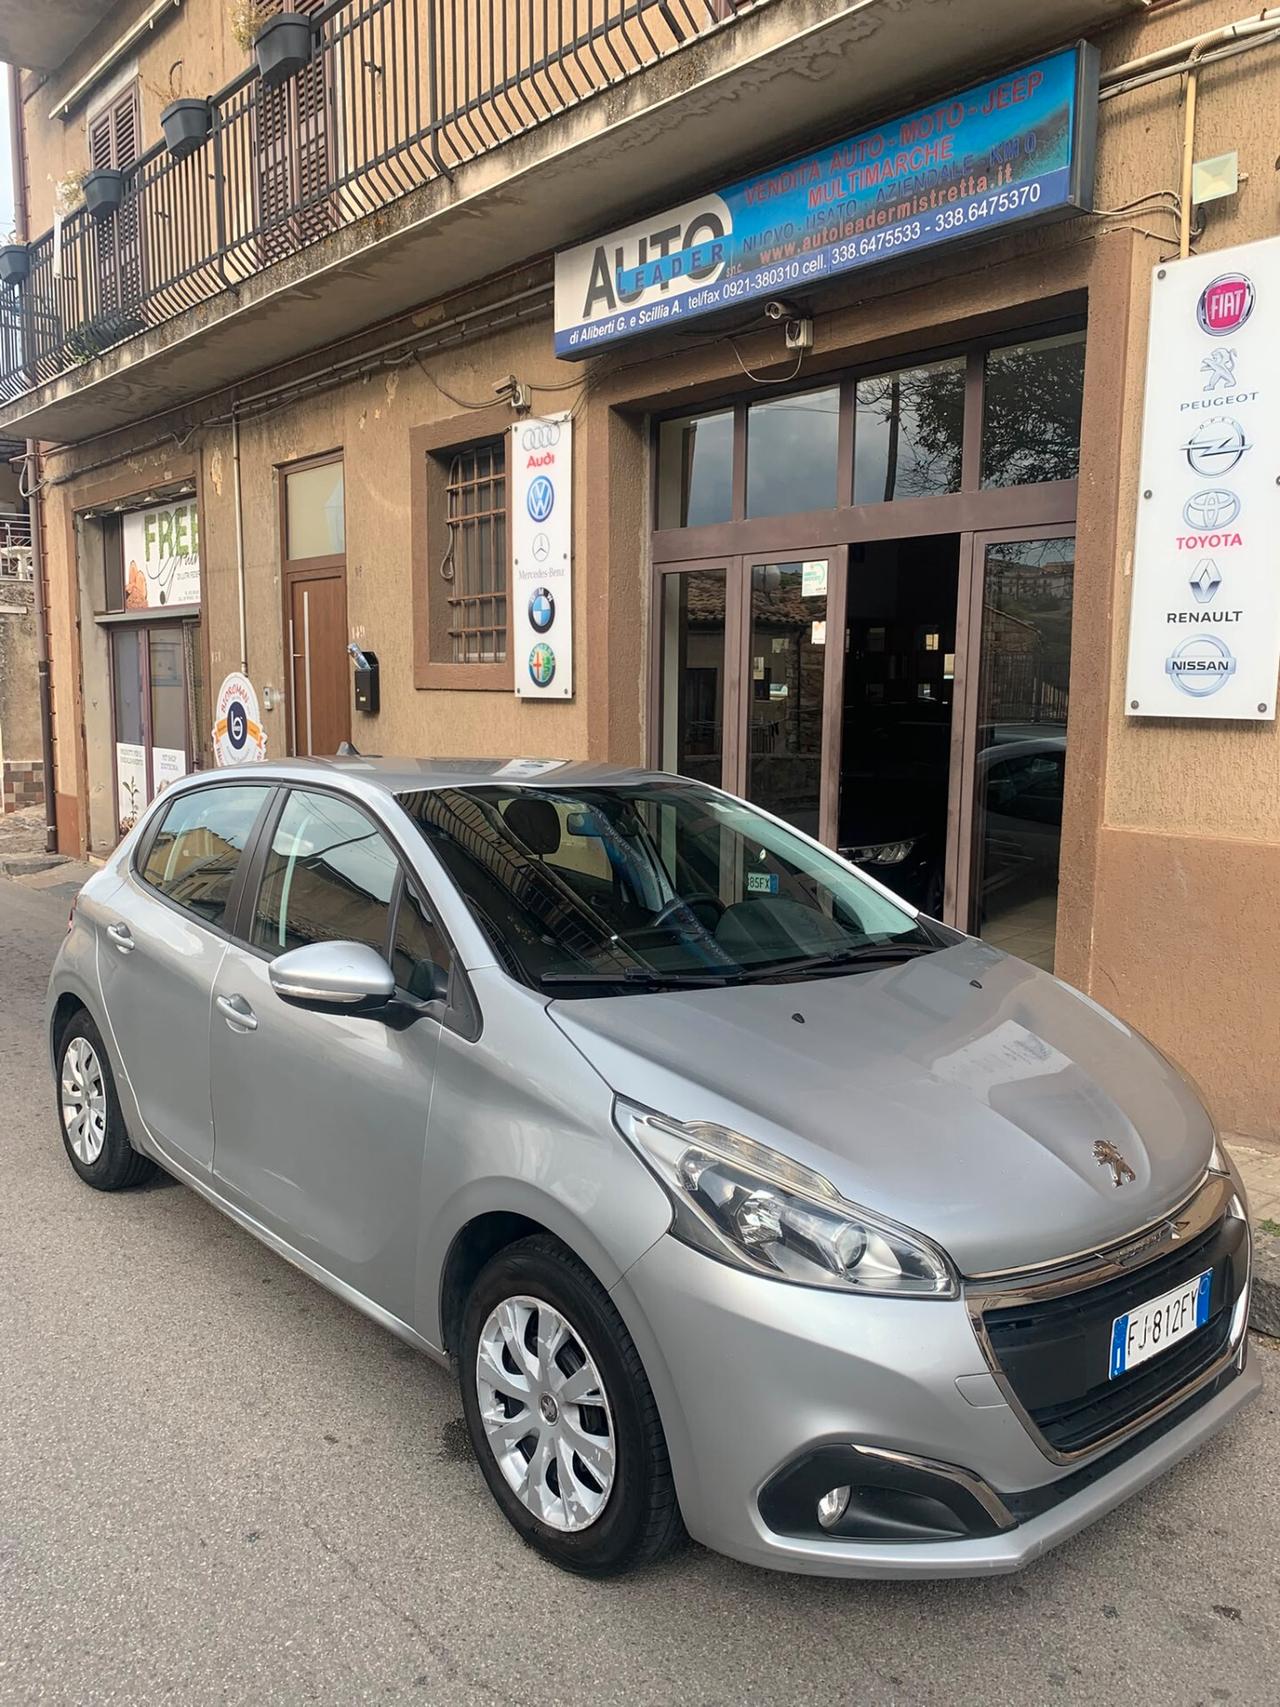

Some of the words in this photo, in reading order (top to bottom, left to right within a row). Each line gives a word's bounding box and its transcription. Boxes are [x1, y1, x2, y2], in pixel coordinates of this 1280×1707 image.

[745, 160, 821, 204] VENDITA
[829, 135, 884, 172] AUTO
[901, 102, 965, 146] MOTO
[981, 70, 1044, 116] JEEP
[808, 135, 955, 209] MULTIMARCHE
[876, 154, 975, 203] AZIENDALE
[760, 162, 1014, 264] www.autoleadermistretta.it
[569, 331, 579, 345] di
[580, 320, 615, 341] Aliberti
[616, 318, 627, 331] G.
[629, 318, 636, 328] e
[638, 304, 670, 325] Scillia
[671, 300, 682, 315] A.
[688, 289, 721, 309] tel/fax
[723, 262, 799, 299] 0921-380310
[802, 255, 827, 275] cell.
[831, 222, 921, 265] 338.6475533
[935, 183, 1041, 232] 338.6475370
[582, 212, 725, 319] AUTO
[617, 243, 724, 295] LEADER
[1210, 289, 1244, 320] FIAT
[1180, 391, 1260, 412] PEUGEOT
[526, 452, 555, 469] Audi
[1176, 533, 1243, 550] TOYOTA
[518, 567, 565, 581] Mercedes-Benz
[1166, 610, 1244, 624] RENAULT
[1171, 660, 1230, 672] NISSAN
[1127, 1287, 1199, 1356] FJ812FY
